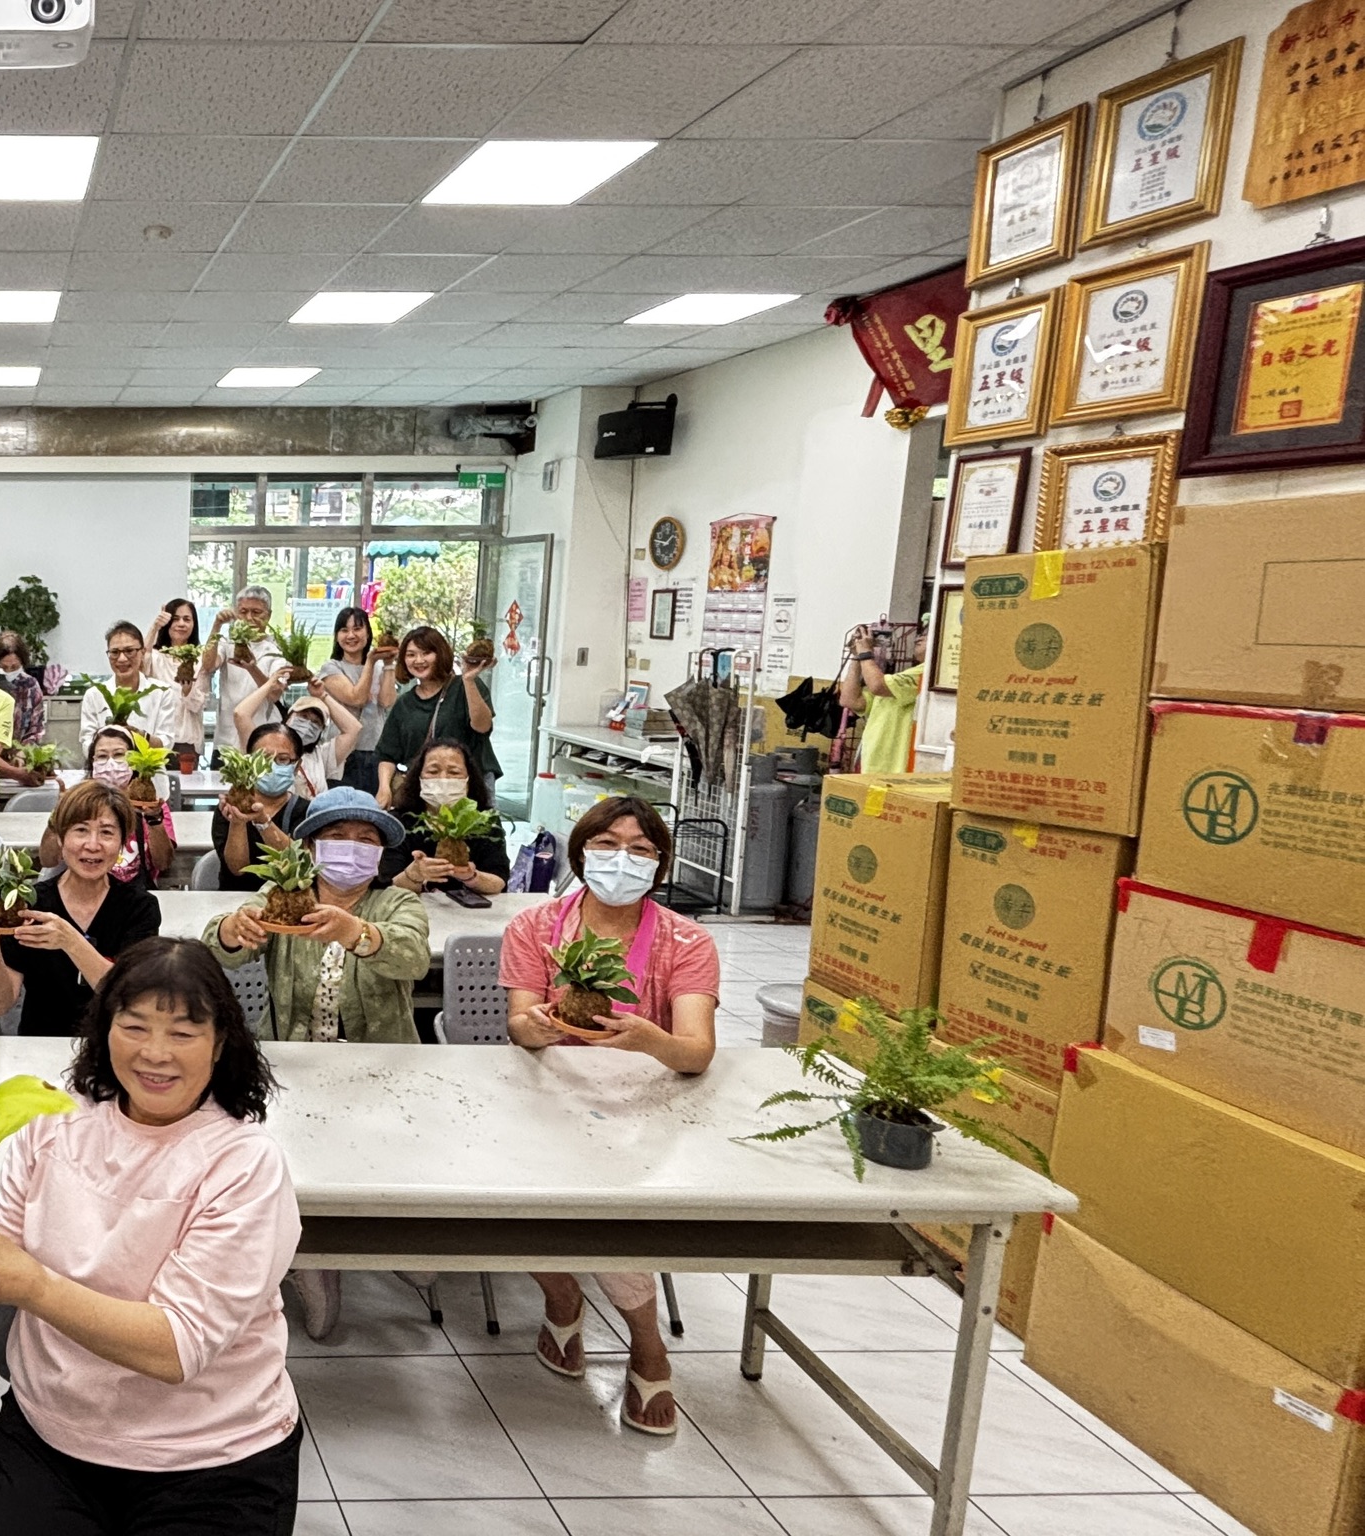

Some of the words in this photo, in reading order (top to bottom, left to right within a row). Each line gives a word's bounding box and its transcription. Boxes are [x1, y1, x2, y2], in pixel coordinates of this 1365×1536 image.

[1131, 145, 1181, 173] 五星級
[1261, 339, 1340, 367] 自治之光
[978, 367, 1025, 391] 五星級
[1079, 518, 1130, 534] 五星級
[1005, 674, 1030, 685] Feel
[1046, 675, 1077, 686] good
[976, 689, 1105, 707] 環保抽取式衛生紙
[986, 926, 1006, 939] Feel
[1019, 938, 1048, 951] good
